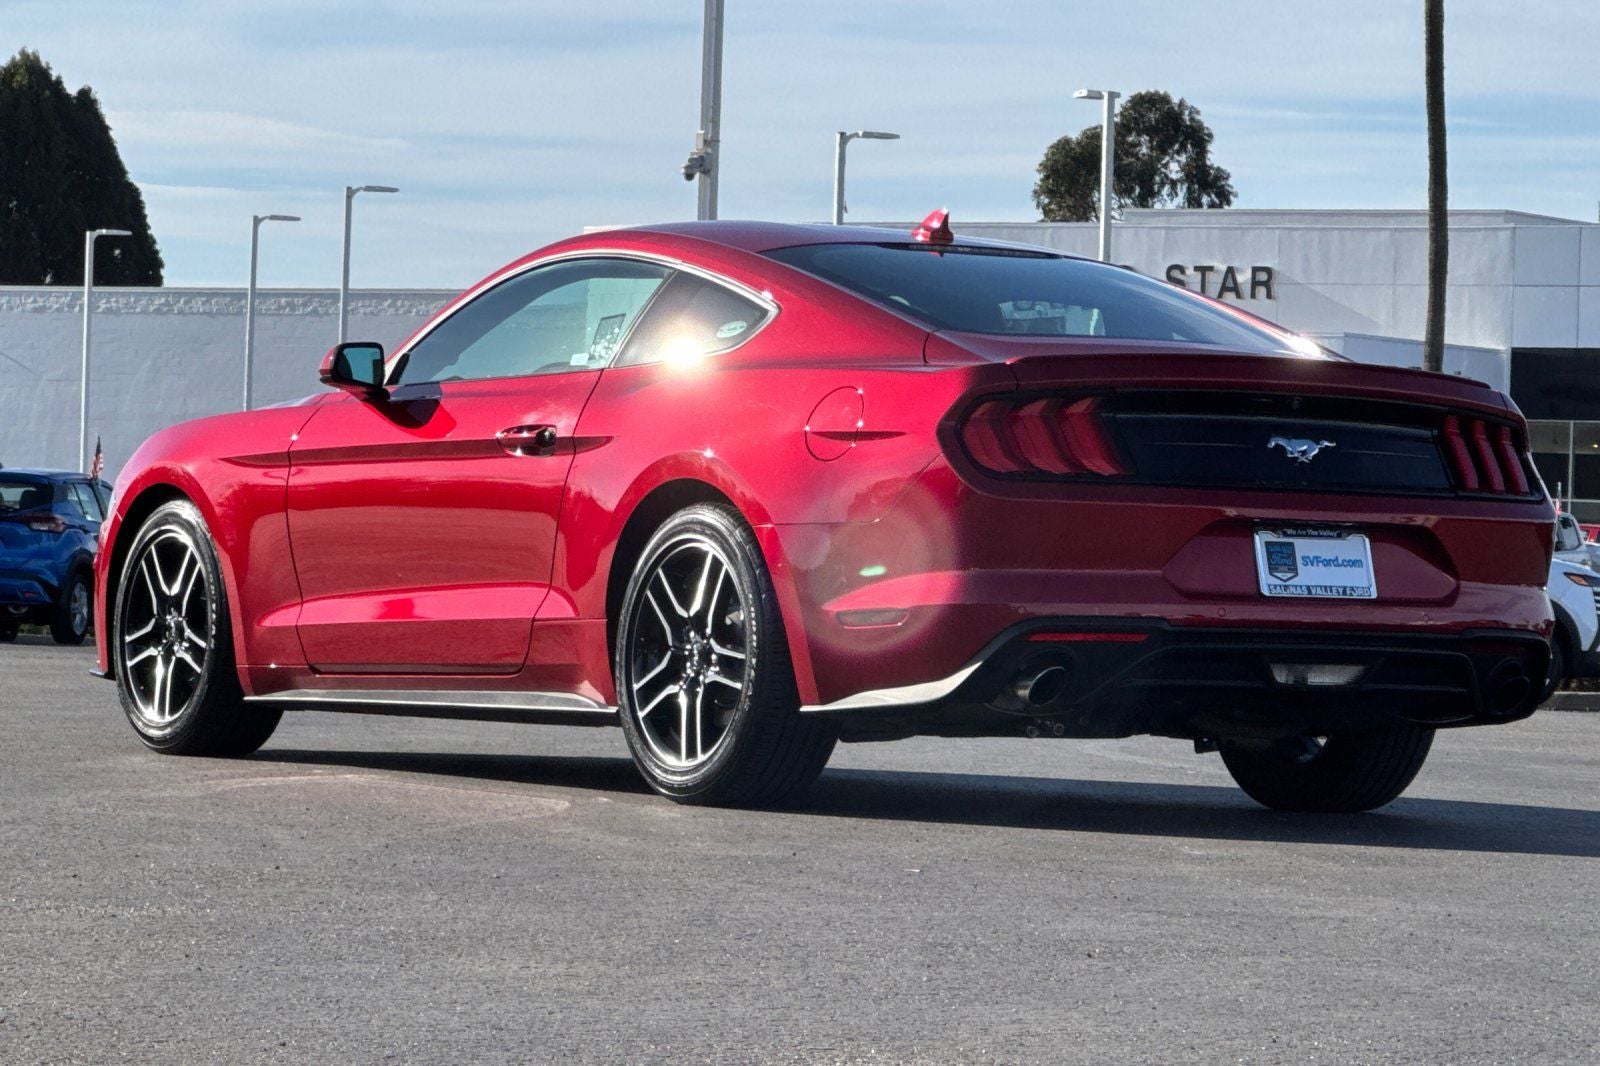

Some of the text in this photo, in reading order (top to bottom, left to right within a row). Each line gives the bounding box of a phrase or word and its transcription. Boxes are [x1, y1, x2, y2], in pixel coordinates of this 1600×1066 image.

[1165, 263, 1274, 300] STAR
[1301, 555, 1363, 568] SVFord.com
[1269, 585, 1371, 597] SALINAS VALLEY FORD
